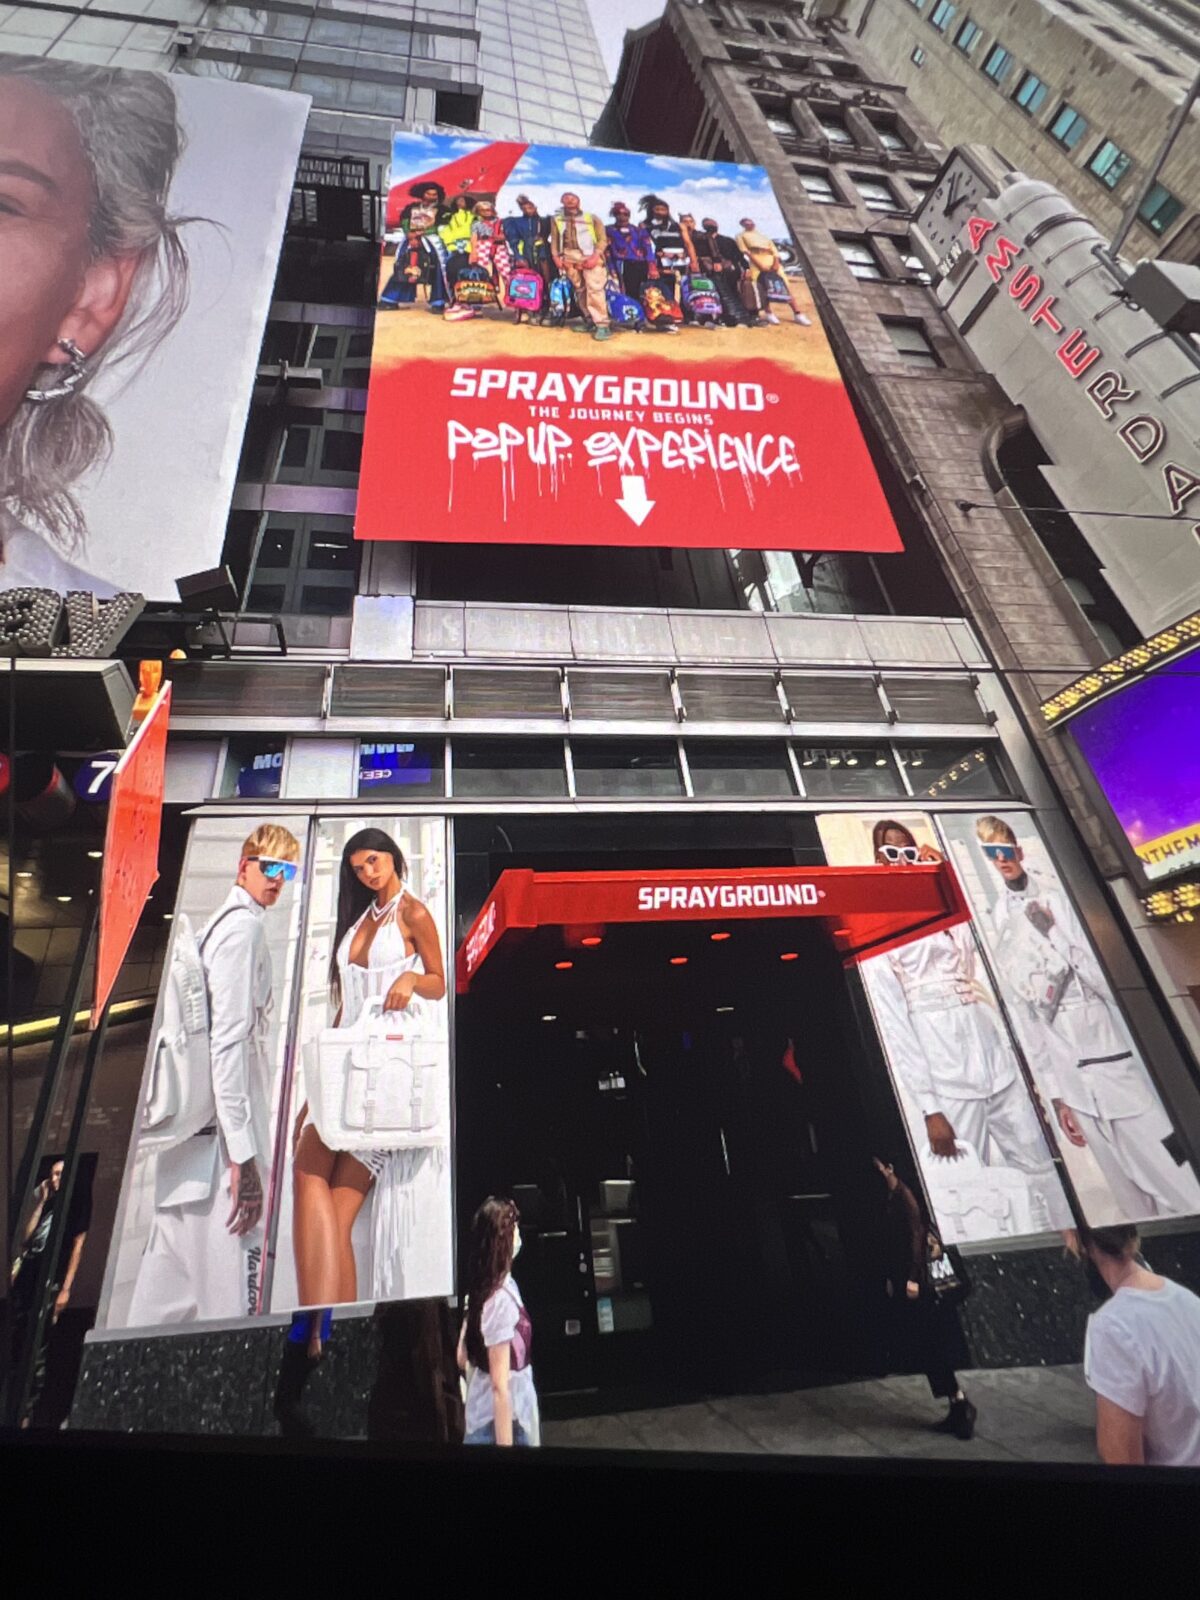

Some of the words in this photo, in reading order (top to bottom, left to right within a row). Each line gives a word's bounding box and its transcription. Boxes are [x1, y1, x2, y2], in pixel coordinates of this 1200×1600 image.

[449, 367, 765, 412] SPRAYGROUND
[966, 216, 1200, 545] AMSTERDA
[528, 405, 560, 419] THE
[568, 407, 645, 423] JOURNEY
[653, 410, 714, 426] BEGINS
[88, 761, 118, 794] 7
[637, 883, 818, 911] SPRAYGROUND
